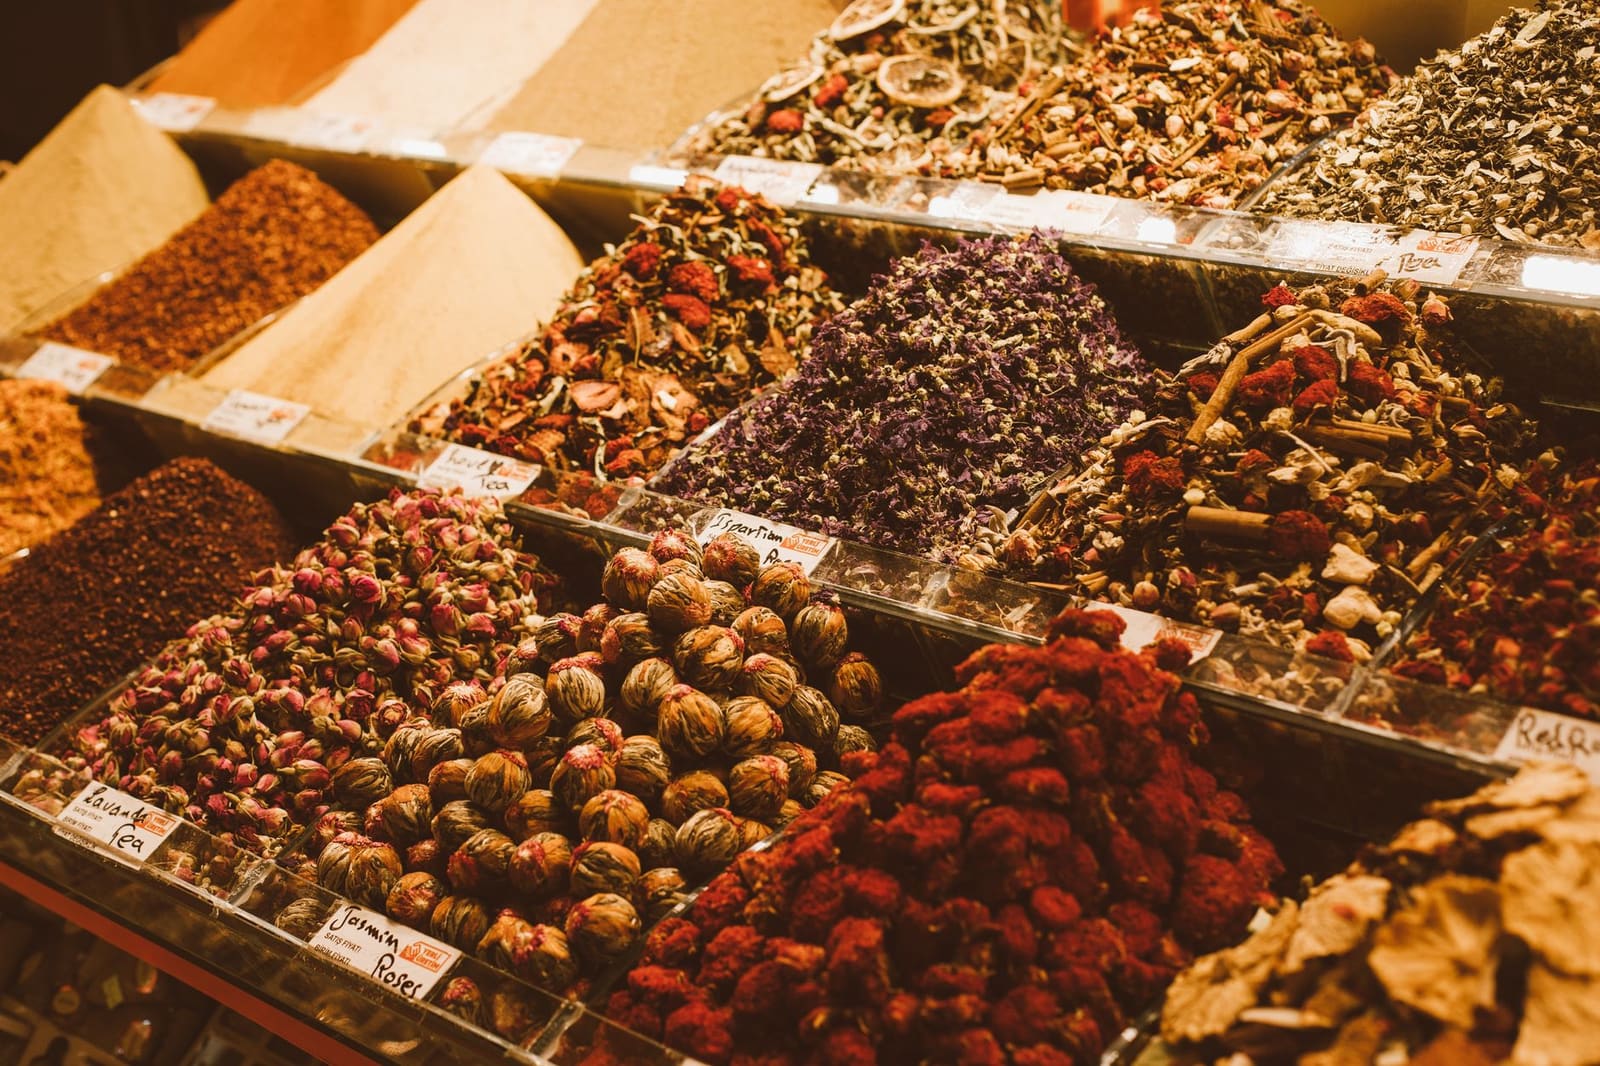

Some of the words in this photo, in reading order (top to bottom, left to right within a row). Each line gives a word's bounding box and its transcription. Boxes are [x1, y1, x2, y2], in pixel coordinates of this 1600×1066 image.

[108, 823, 145, 853] Tea
[329, 905, 399, 954] Jasmin
[371, 953, 423, 999] Roses
